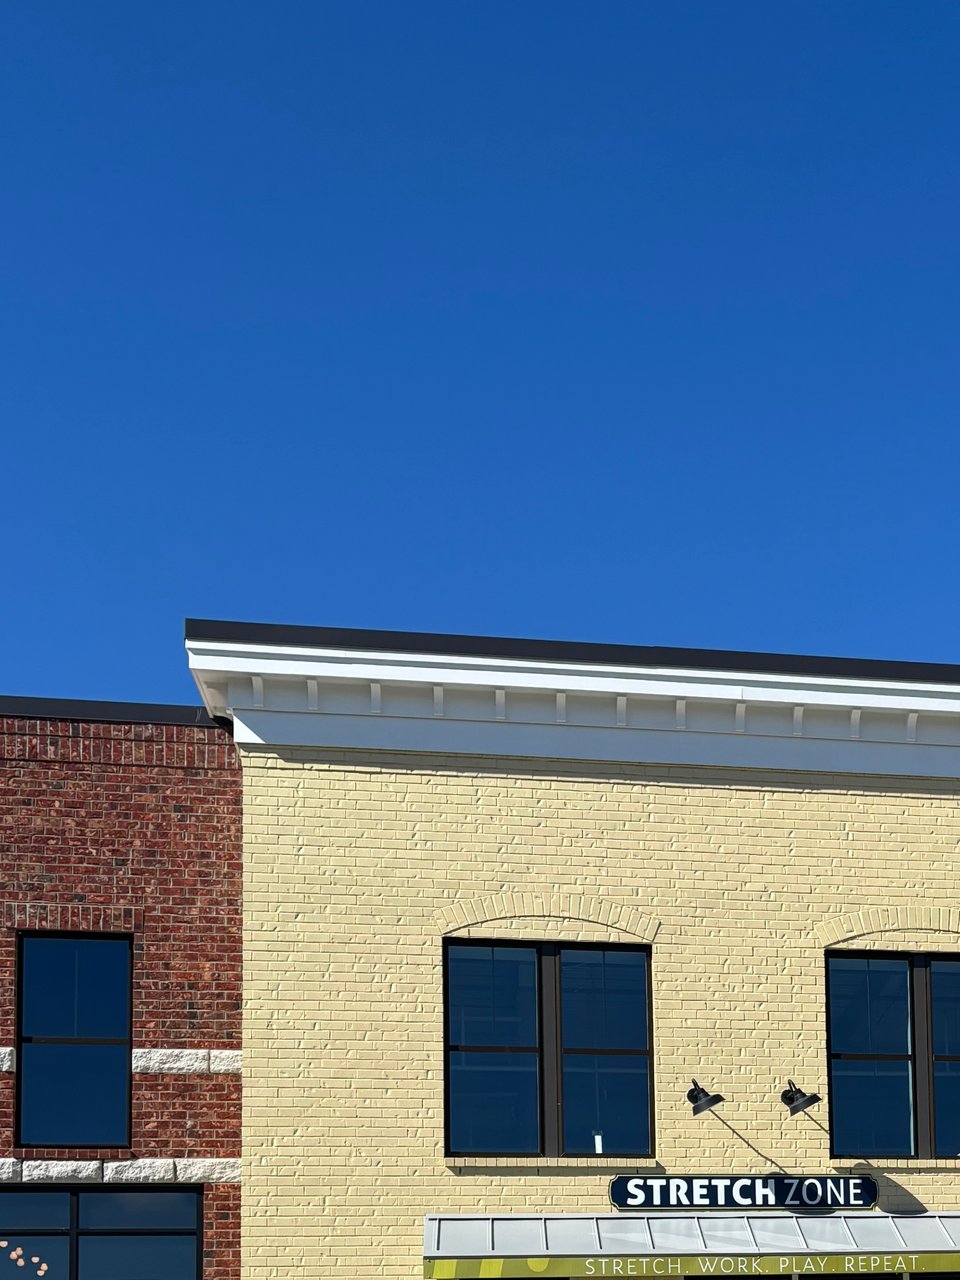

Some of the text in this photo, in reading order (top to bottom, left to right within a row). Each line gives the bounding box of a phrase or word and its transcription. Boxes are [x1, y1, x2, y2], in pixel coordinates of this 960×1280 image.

[626, 1178, 864, 1206] STRETCH ZONE
[585, 1255, 926, 1275] STRETCH. WORK. PLAY. REPEAT.
